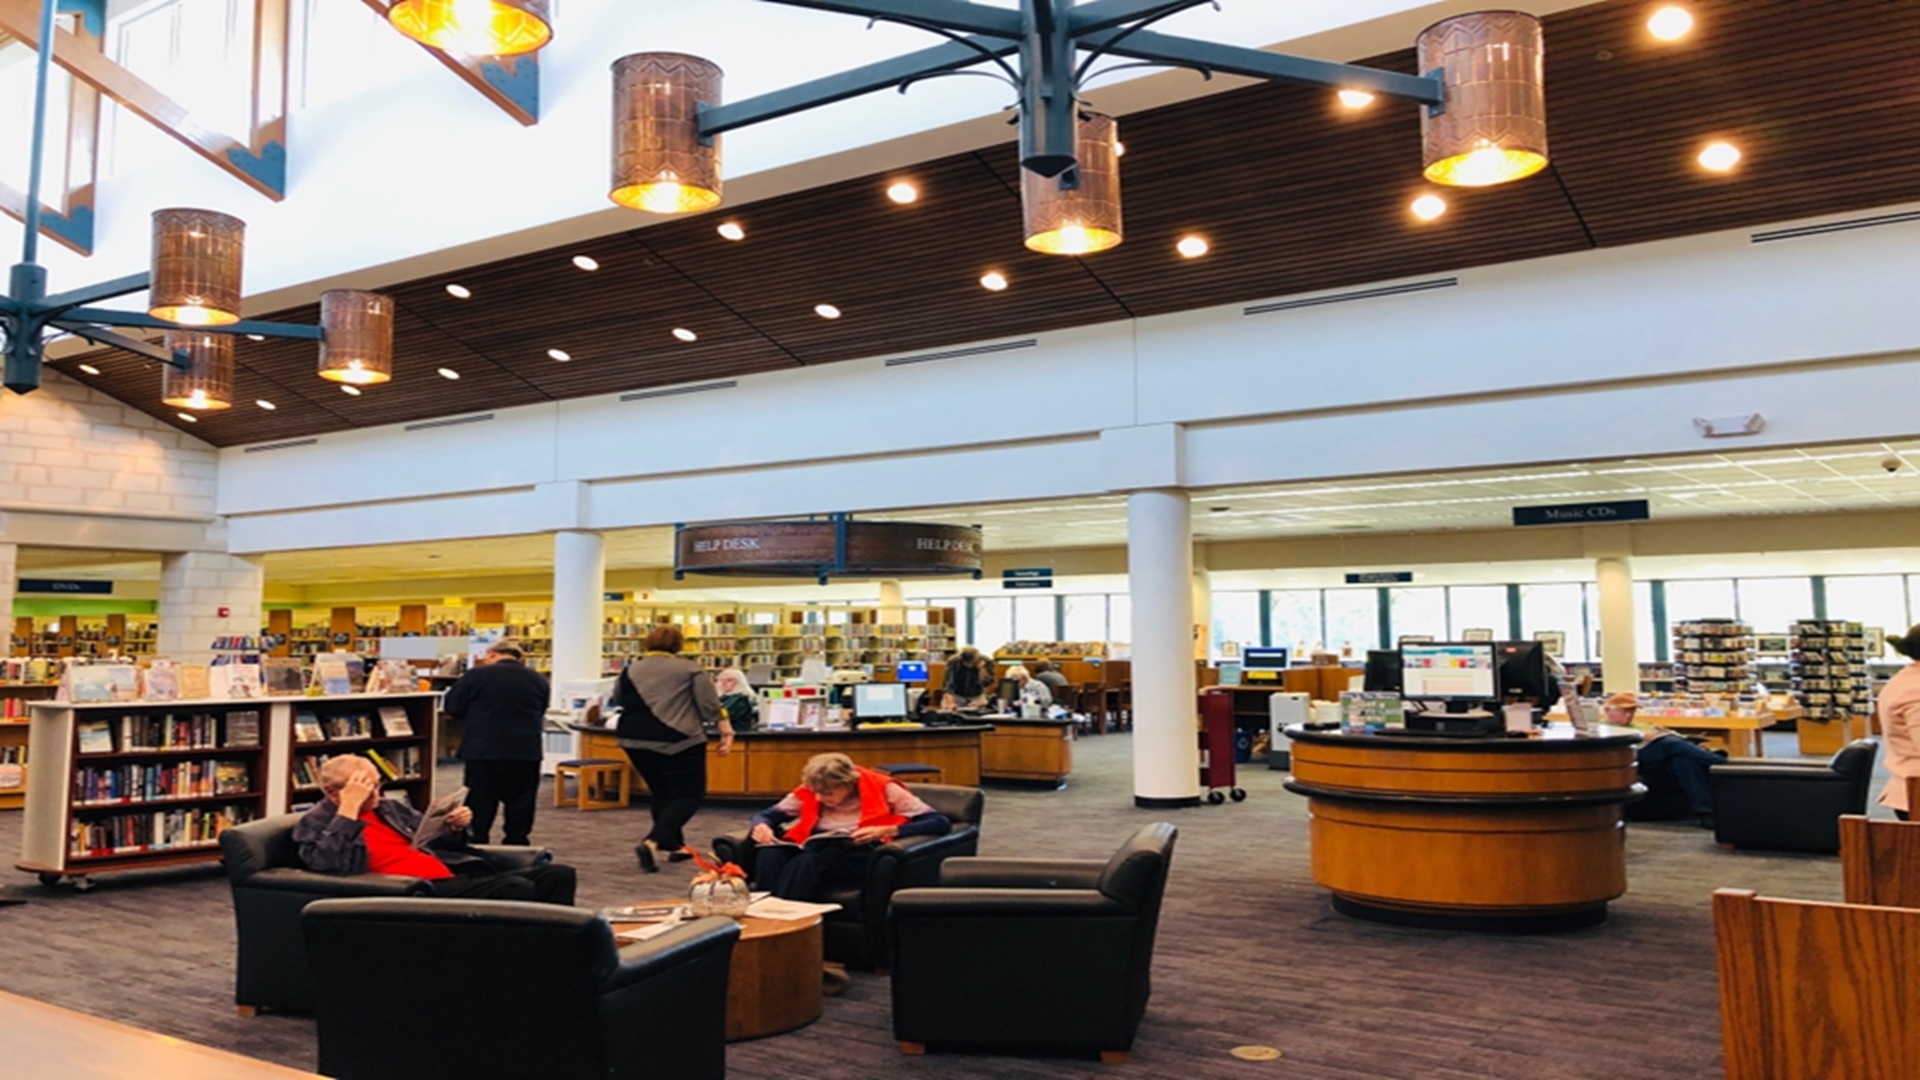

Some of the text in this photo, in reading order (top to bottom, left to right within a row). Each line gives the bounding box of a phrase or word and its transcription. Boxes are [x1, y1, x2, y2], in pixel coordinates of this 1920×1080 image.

[1545, 506, 1617, 519] Music CDs
[694, 538, 759, 552] HELP DESK
[917, 538, 951, 550] HELP
